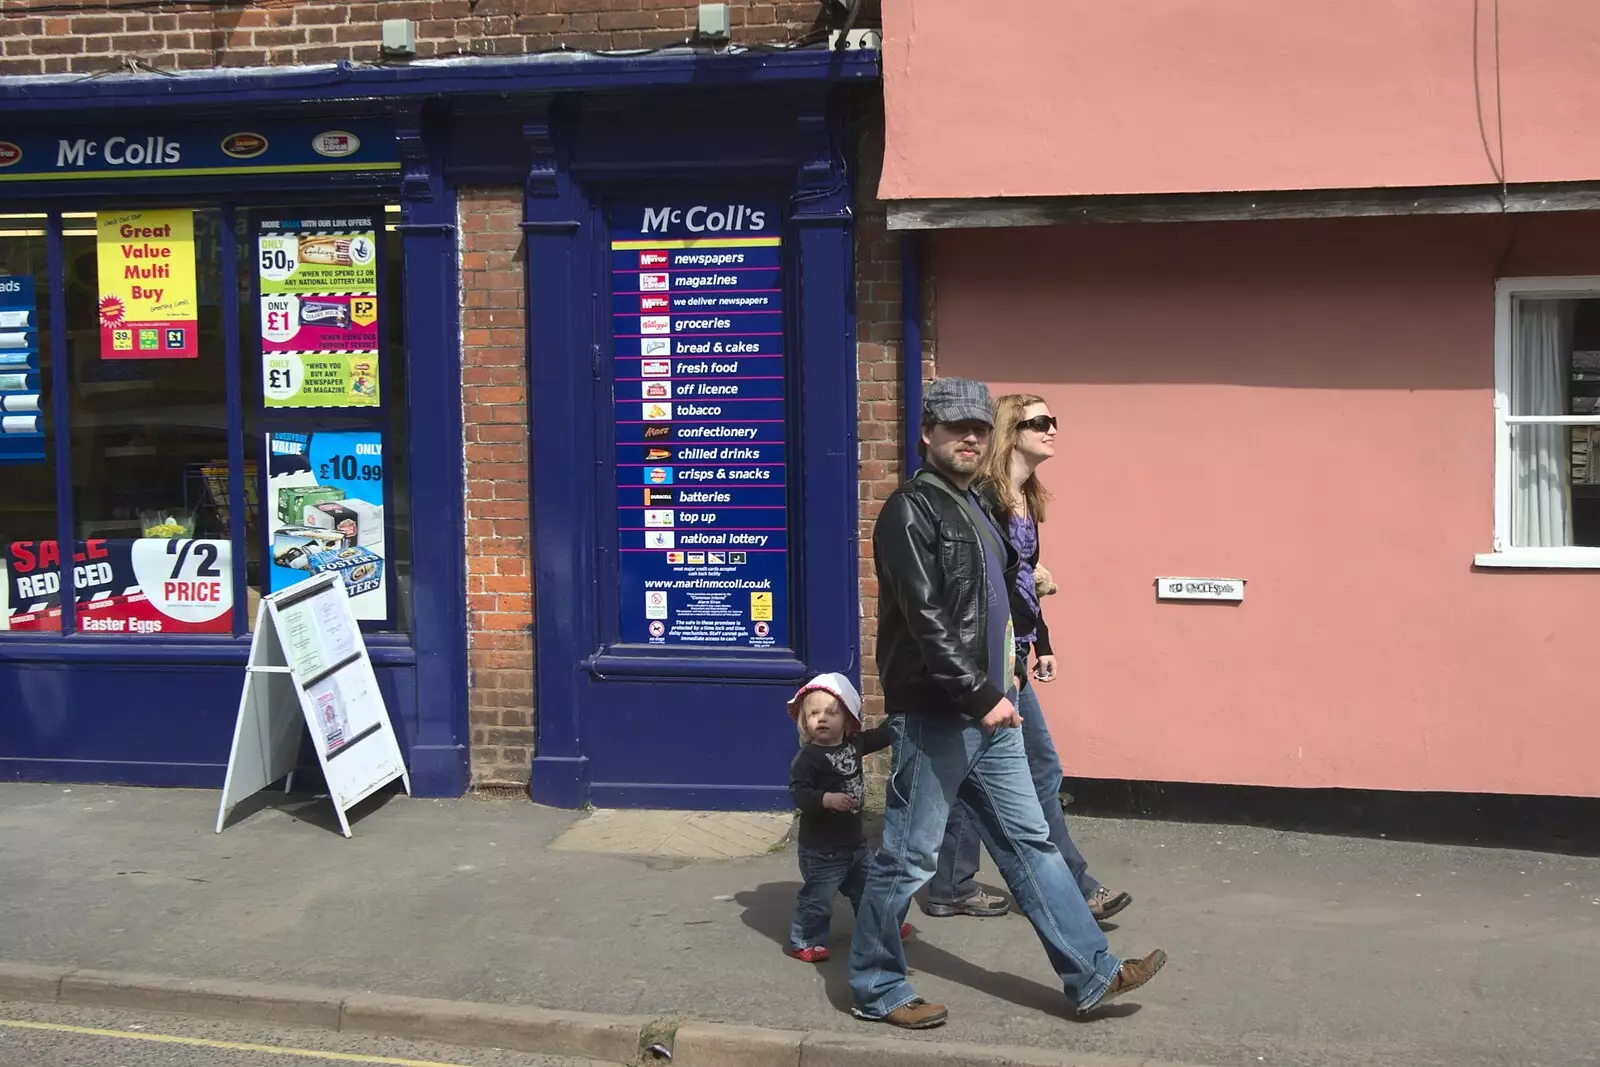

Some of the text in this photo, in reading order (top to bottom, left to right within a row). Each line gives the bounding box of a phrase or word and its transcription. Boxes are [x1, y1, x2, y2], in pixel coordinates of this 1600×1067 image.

[120, 224, 171, 238] Great
[262, 240, 284, 248] ONLY
[121, 243, 171, 259] Value
[304, 246, 334, 260] Galaxy
[262, 250, 294, 271] 50p
[674, 253, 744, 266] newspapers
[124, 264, 169, 279] Multi
[675, 274, 737, 288] magazines
[132, 286, 163, 303] Buy
[268, 302, 288, 310] ONLY
[674, 296, 768, 307] we deliver newspapers
[267, 312, 289, 331] £1
[675, 318, 731, 331] groceries
[168, 332, 181, 341] £1
[676, 342, 710, 353] bread
[713, 342, 723, 353] &
[725, 341, 760, 353] cakes
[676, 362, 738, 374] fresh food
[269, 369, 291, 388] £1
[313, 386, 345, 394] MAGAZINE
[677, 384, 695, 395] off
[698, 383, 738, 395] licence
[677, 405, 722, 416] tobacco
[677, 426, 757, 439] confectionery
[272, 440, 302, 455] VALUE
[356, 444, 382, 455] ONLY
[678, 448, 760, 460] chilled drinks
[320, 454, 382, 481] £10.99
[678, 468, 714, 481] crisps
[716, 468, 726, 479] &
[728, 468, 770, 479] snacks
[679, 491, 730, 502] batteries
[680, 512, 716, 524] top up
[680, 533, 768, 546] national lottery
[318, 555, 378, 572] FOSTER'S
[17, 562, 113, 599] REDCED
[644, 579, 771, 589] www.martinmccoll.co.uk
[164, 582, 221, 601] PRICE
[82, 616, 162, 633] Easter Eggs
